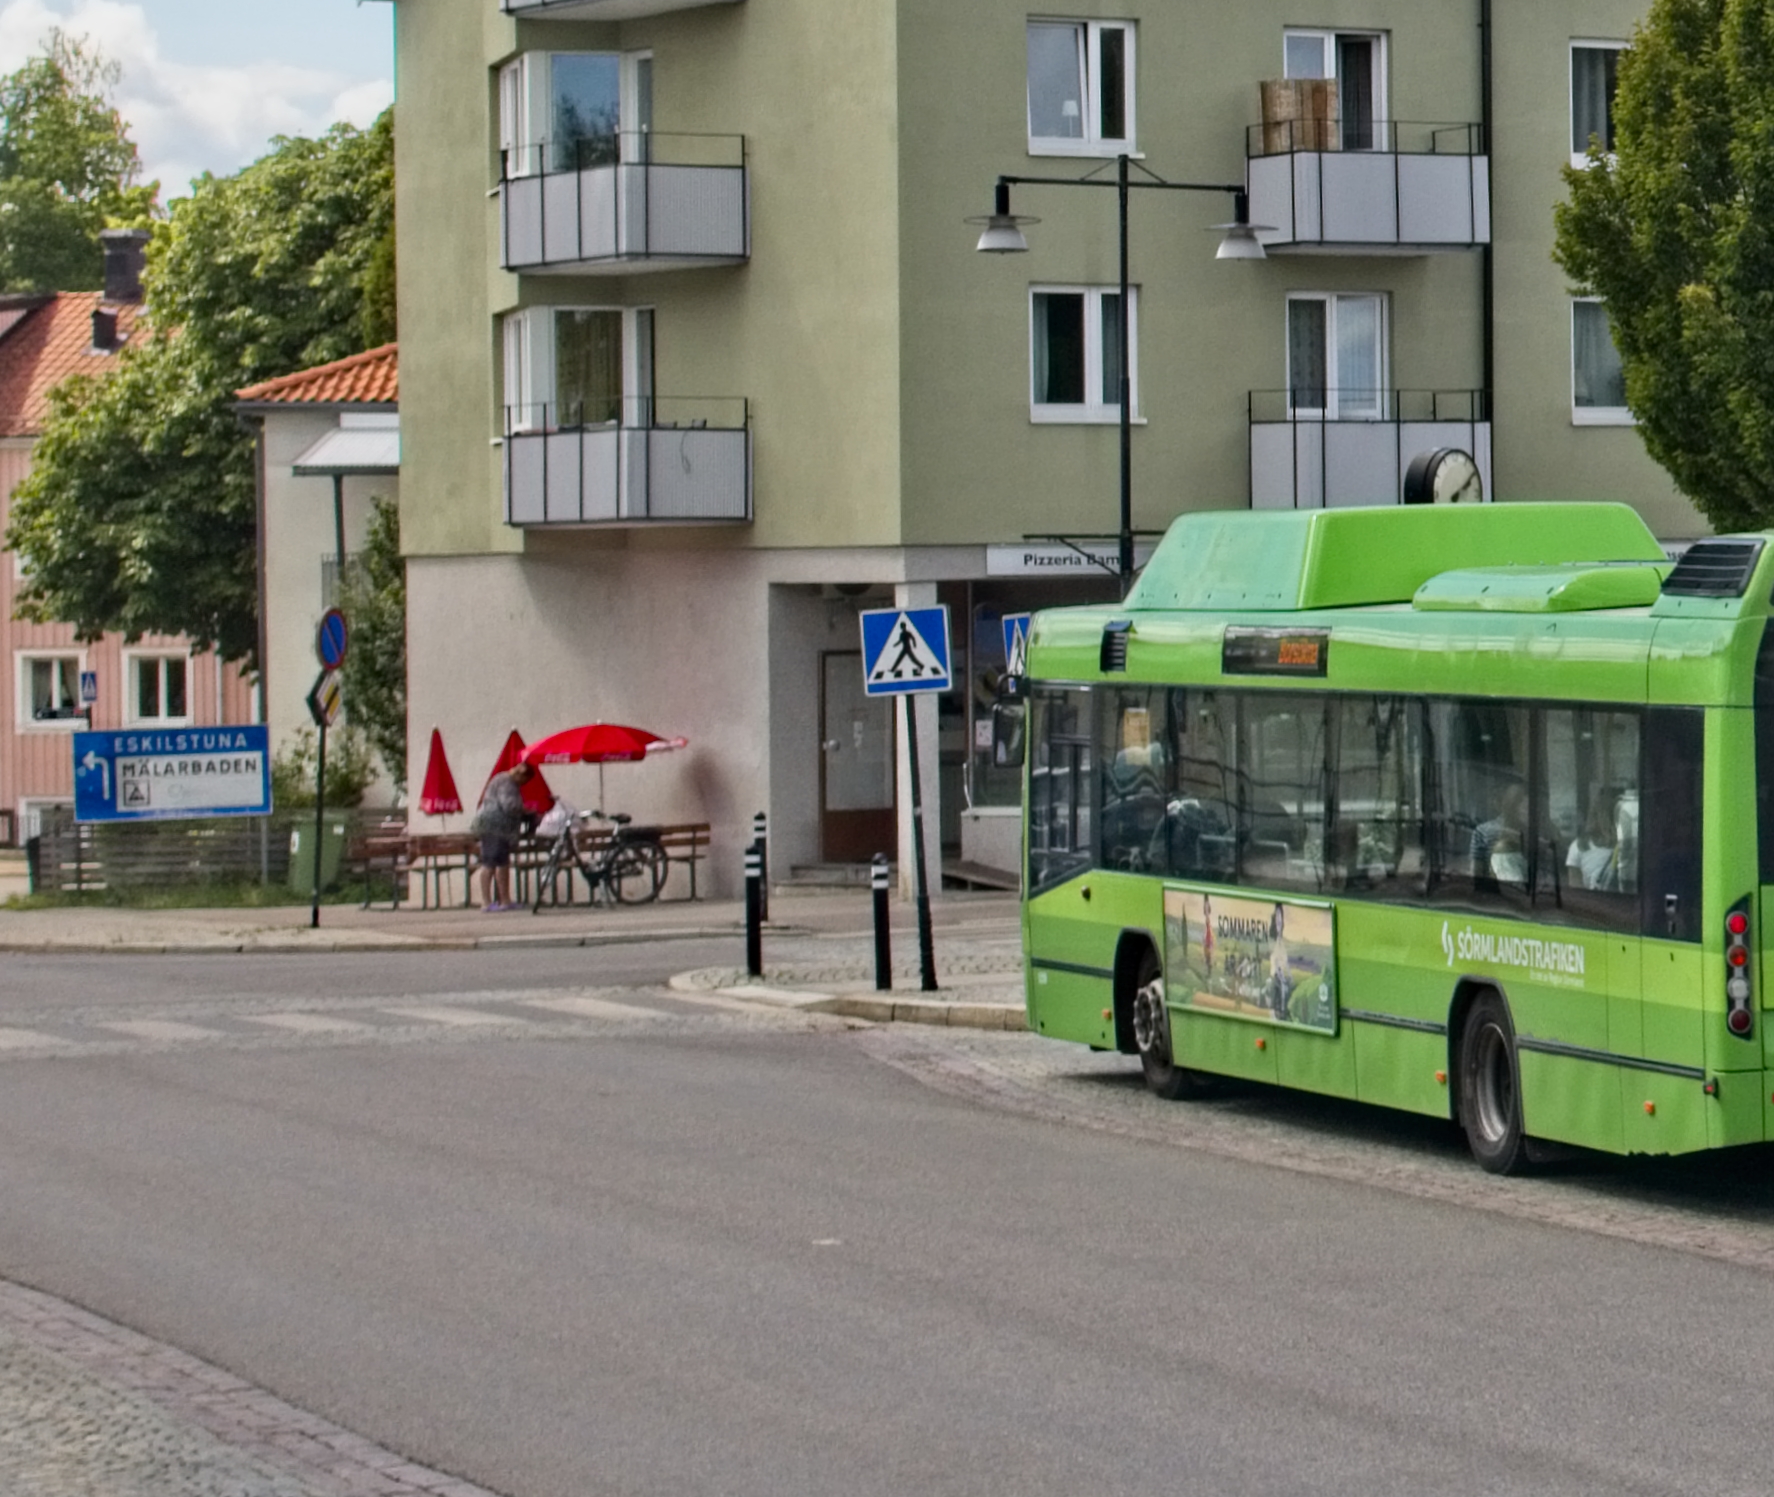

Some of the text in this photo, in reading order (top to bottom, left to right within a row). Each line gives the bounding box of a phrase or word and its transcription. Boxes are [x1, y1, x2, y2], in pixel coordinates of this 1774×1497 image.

[1023, 553, 1083, 566] Pizzeria
[113, 732, 248, 753] ESKILSTUNA
[121, 757, 258, 778] MÄLARBADEN
[1217, 914, 1269, 944] SOMMAREN
[1457, 925, 1585, 974] SÖRMLANDSTRAFIKEN
